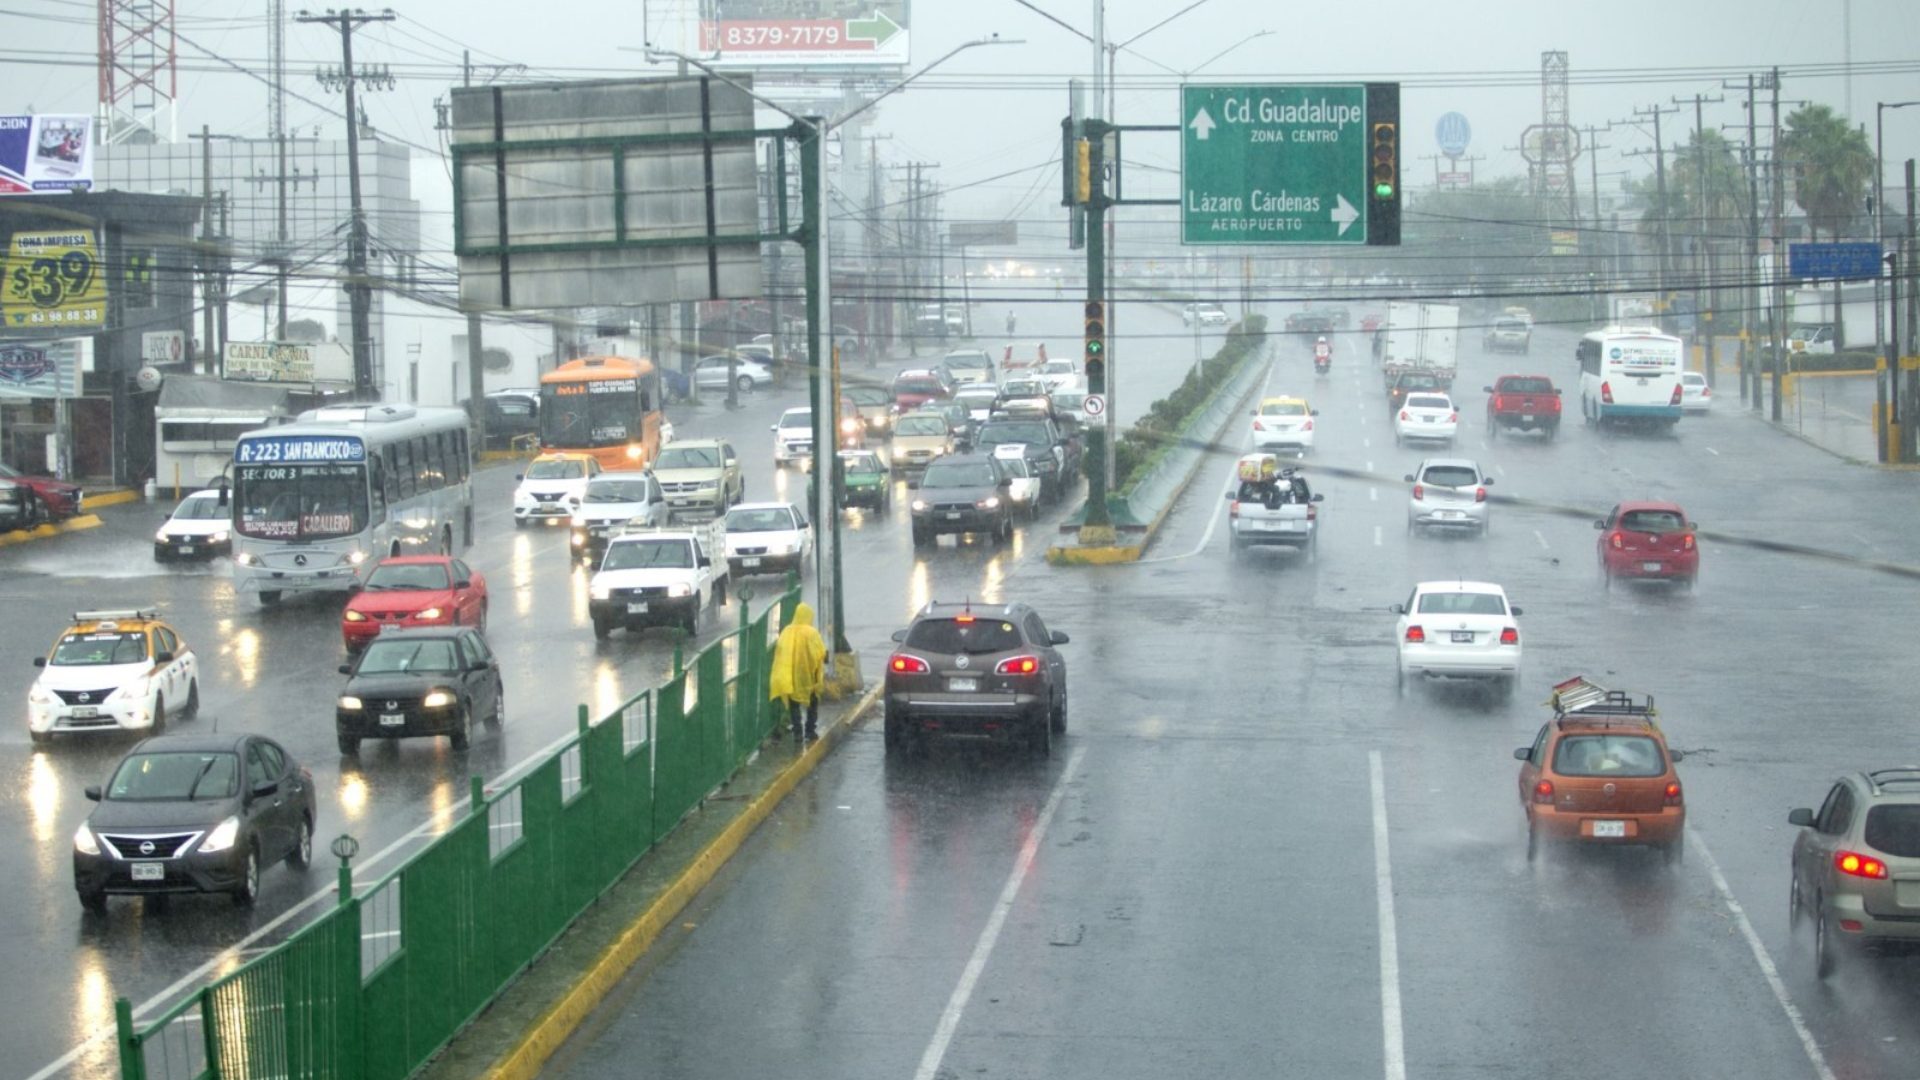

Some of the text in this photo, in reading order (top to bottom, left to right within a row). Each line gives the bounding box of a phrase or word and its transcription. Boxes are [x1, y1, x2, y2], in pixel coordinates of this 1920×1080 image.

[1224, 98, 1361, 130] Cd. Guadalupe
[1250, 130, 1338, 142] ZONA CENTRO
[1189, 189, 1320, 212] Lázaro Cárdenas
[1211, 218, 1302, 231] AEROPUERTO
[12, 250, 94, 308] $39
[229, 345, 266, 359] CARNE
[240, 443, 280, 461] R-223
[284, 442, 302, 460] SAN
[303, 441, 349, 460] FRANCISCO
[289, 468, 296, 479] 3
